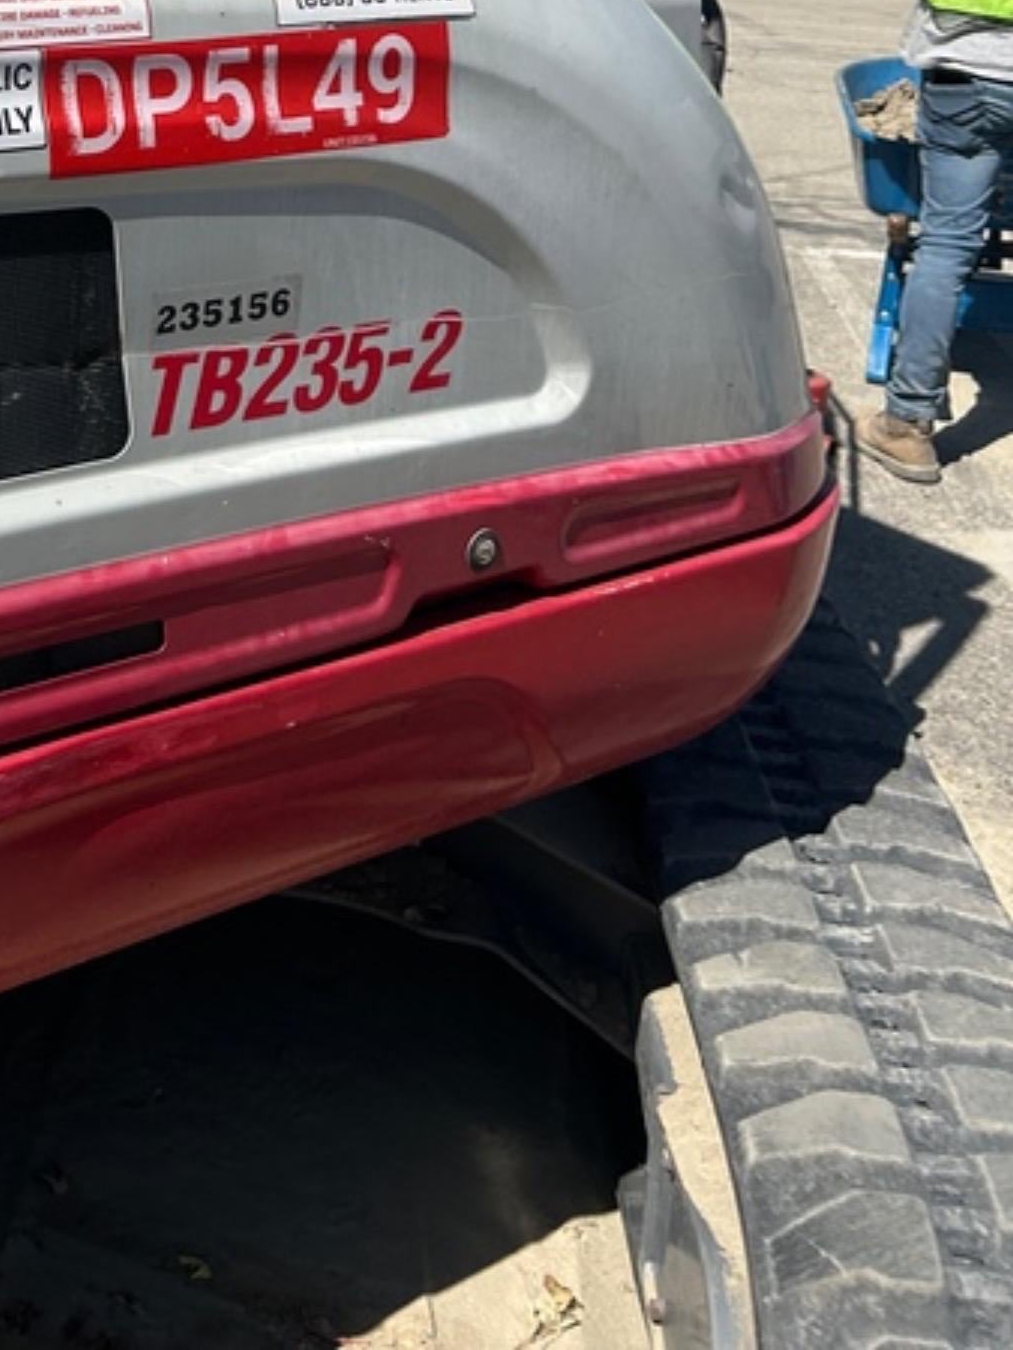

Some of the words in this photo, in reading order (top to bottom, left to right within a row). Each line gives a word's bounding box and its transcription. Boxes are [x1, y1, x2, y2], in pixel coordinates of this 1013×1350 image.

[61, 32, 416, 156] DP5L49
[151, 309, 464, 438] TB235-2
[156, 288, 292, 336] 235156
